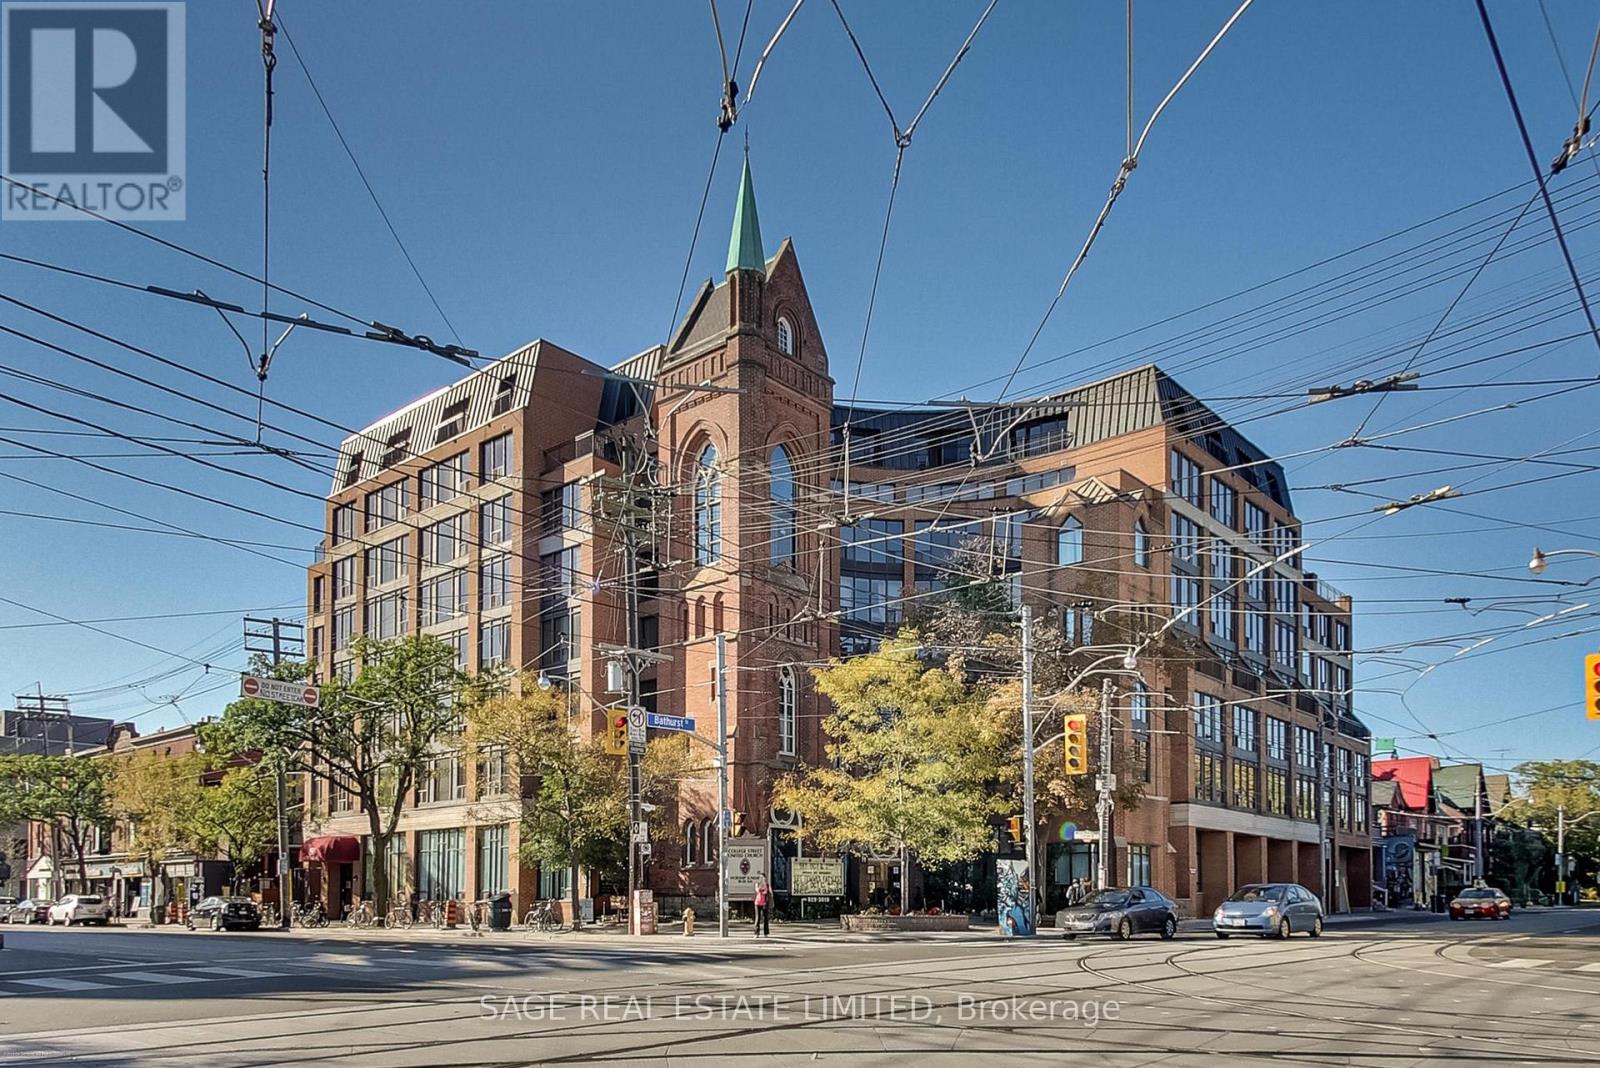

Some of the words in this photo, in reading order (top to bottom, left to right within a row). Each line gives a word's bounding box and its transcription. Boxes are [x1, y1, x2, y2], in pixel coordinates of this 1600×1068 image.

[260, 689, 270, 698] NO
[283, 686, 301, 694] ENTER
[654, 715, 684, 728] Bathurst
